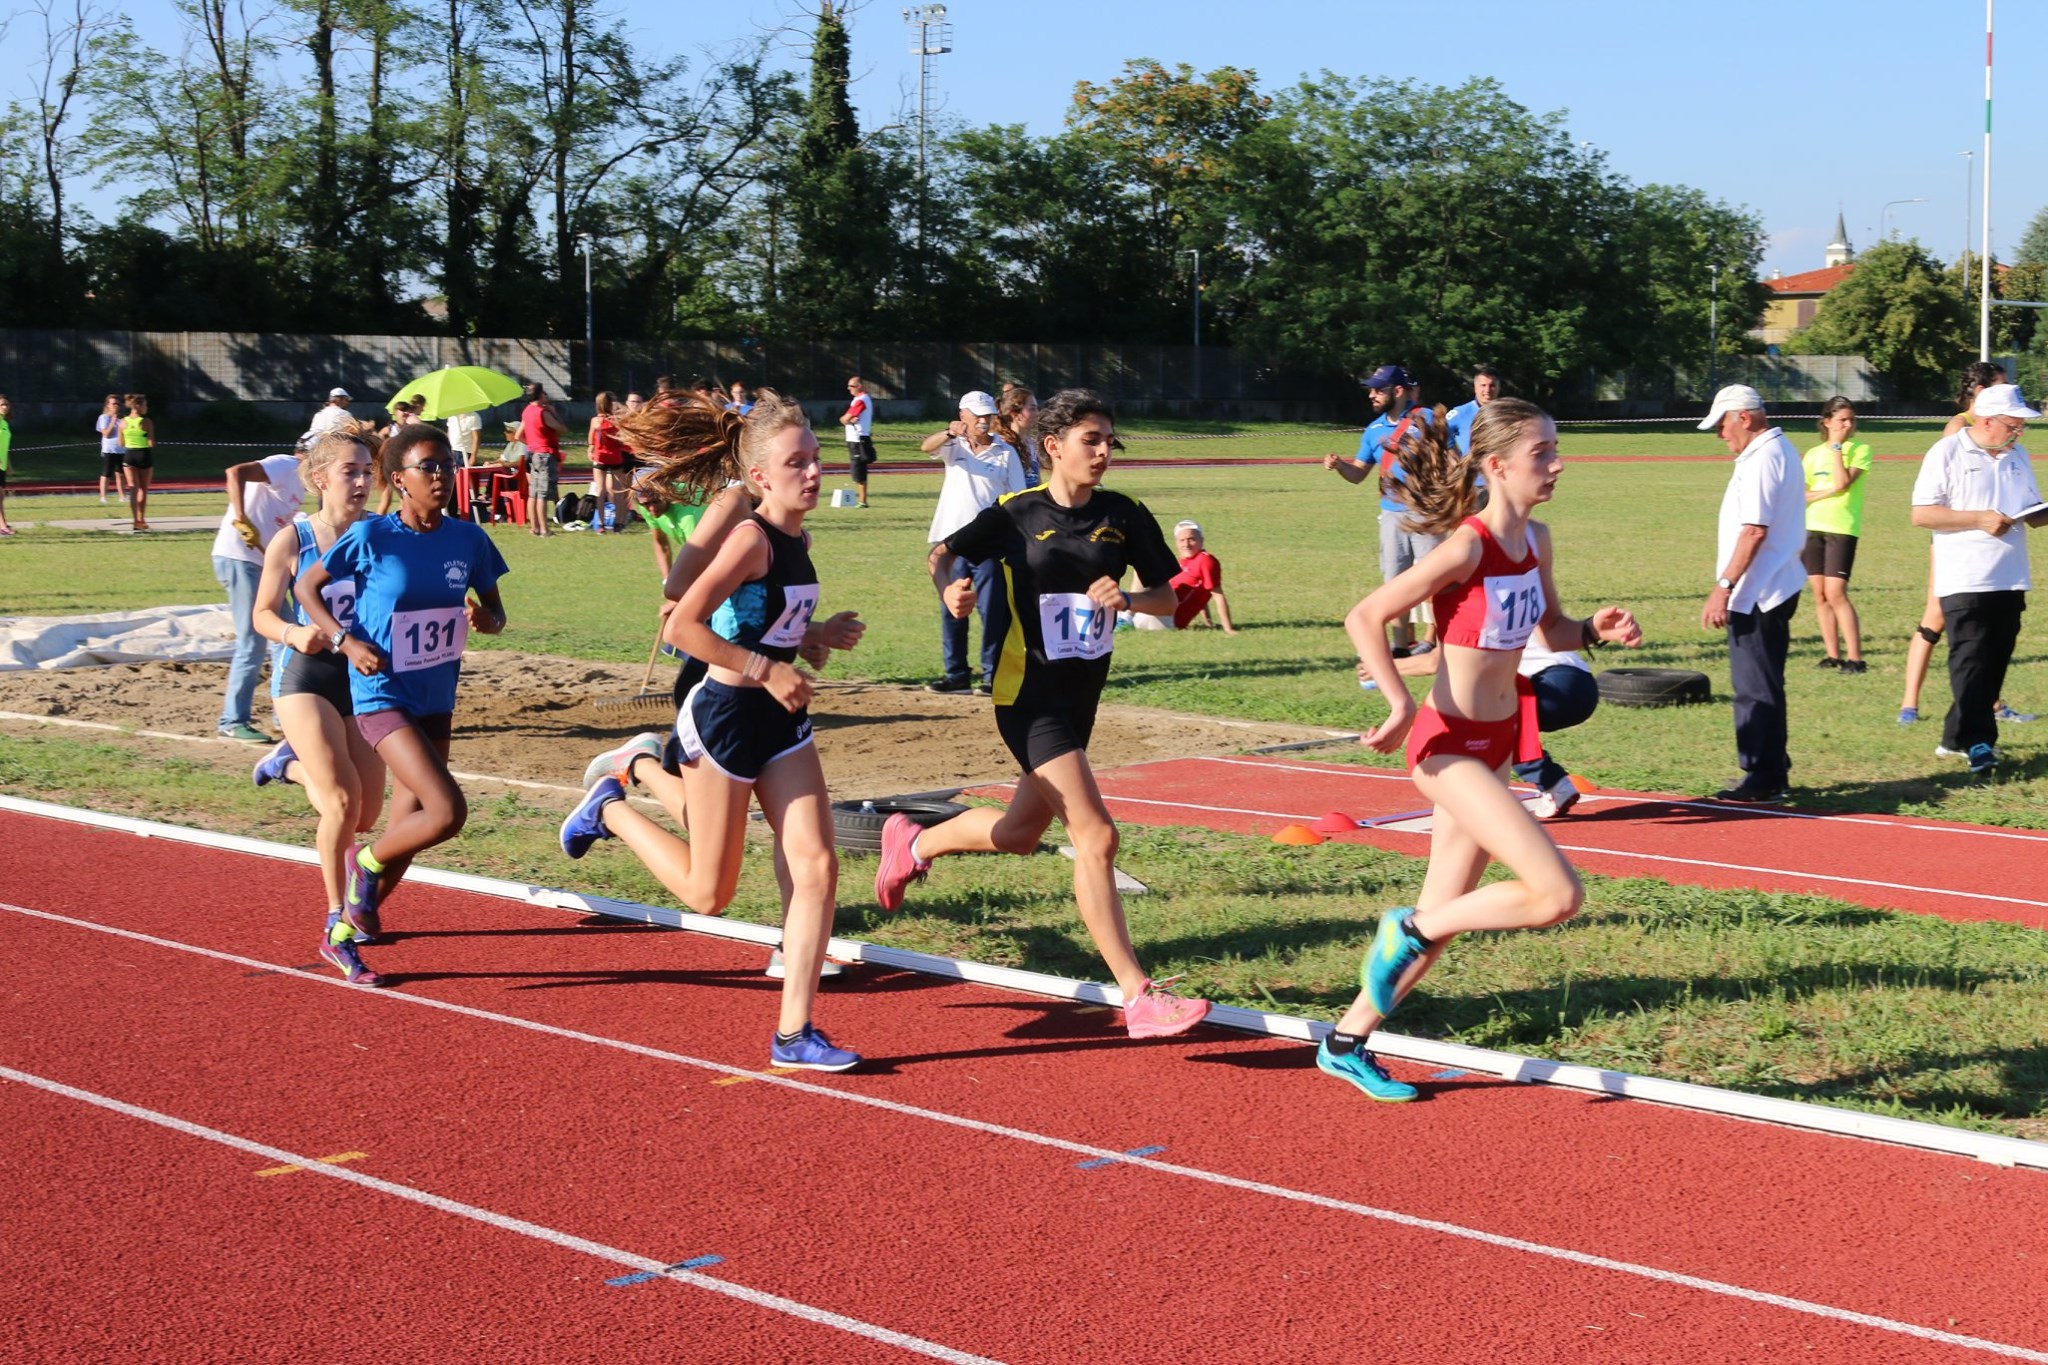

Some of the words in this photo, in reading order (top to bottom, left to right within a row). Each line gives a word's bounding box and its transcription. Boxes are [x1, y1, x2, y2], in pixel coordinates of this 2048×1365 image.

[1054, 606, 1106, 642] 179
[1501, 586, 1540, 631] 178
[405, 618, 457, 655] 131
